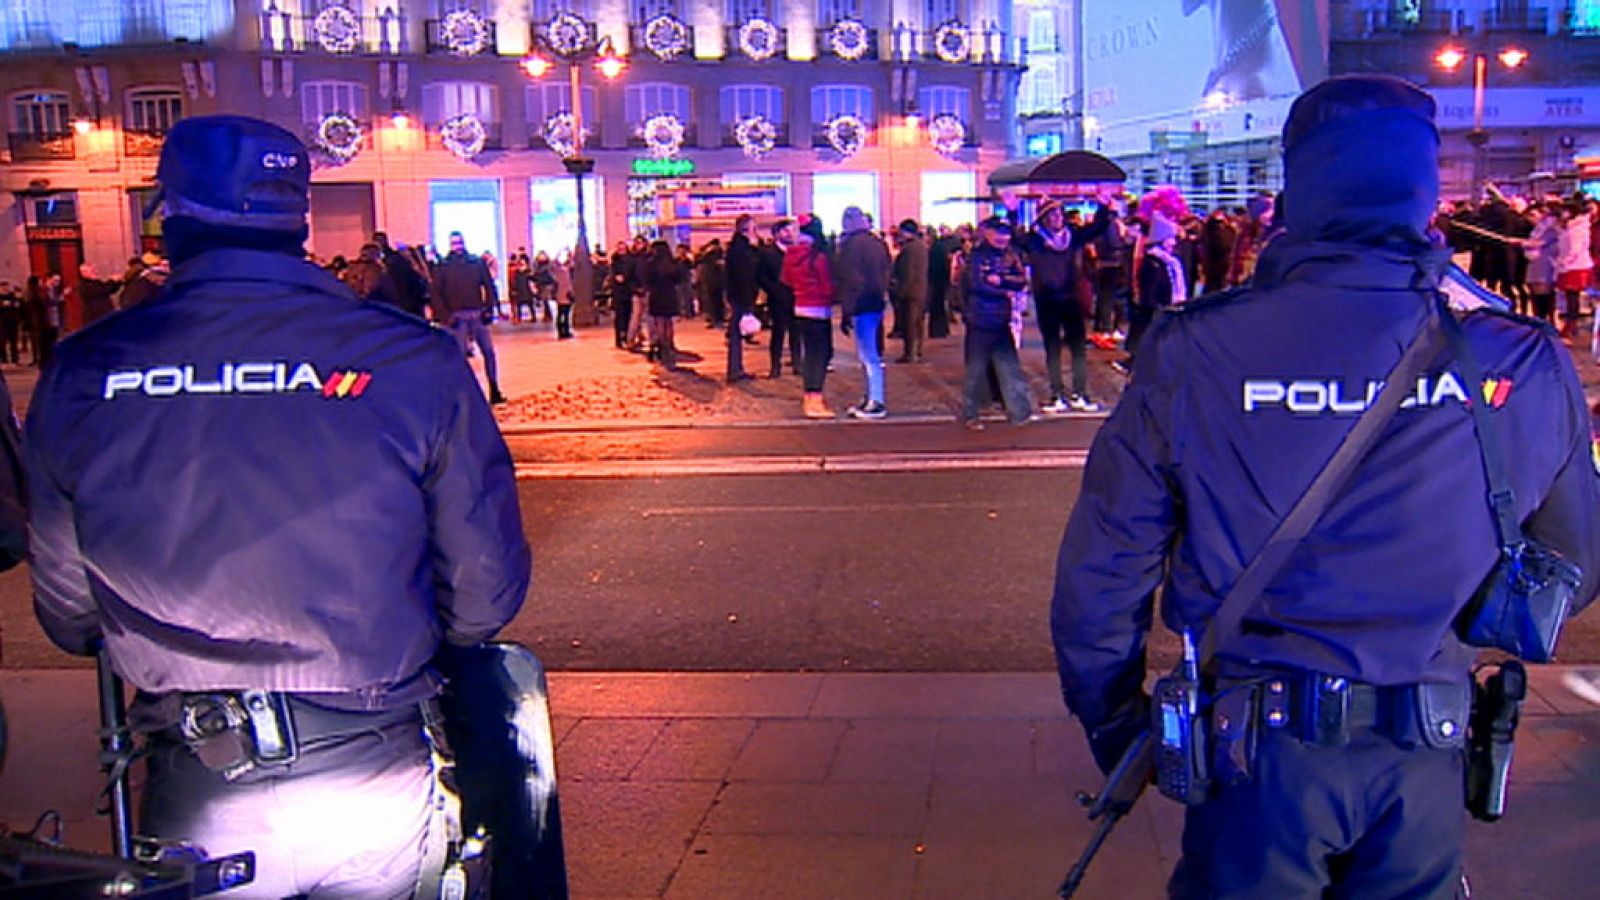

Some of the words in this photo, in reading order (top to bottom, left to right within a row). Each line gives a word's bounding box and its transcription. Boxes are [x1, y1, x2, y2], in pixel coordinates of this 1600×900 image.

[1087, 16, 1159, 61] CROWN
[104, 362, 323, 400] POLICIA
[1244, 371, 1467, 412] POLIIA
